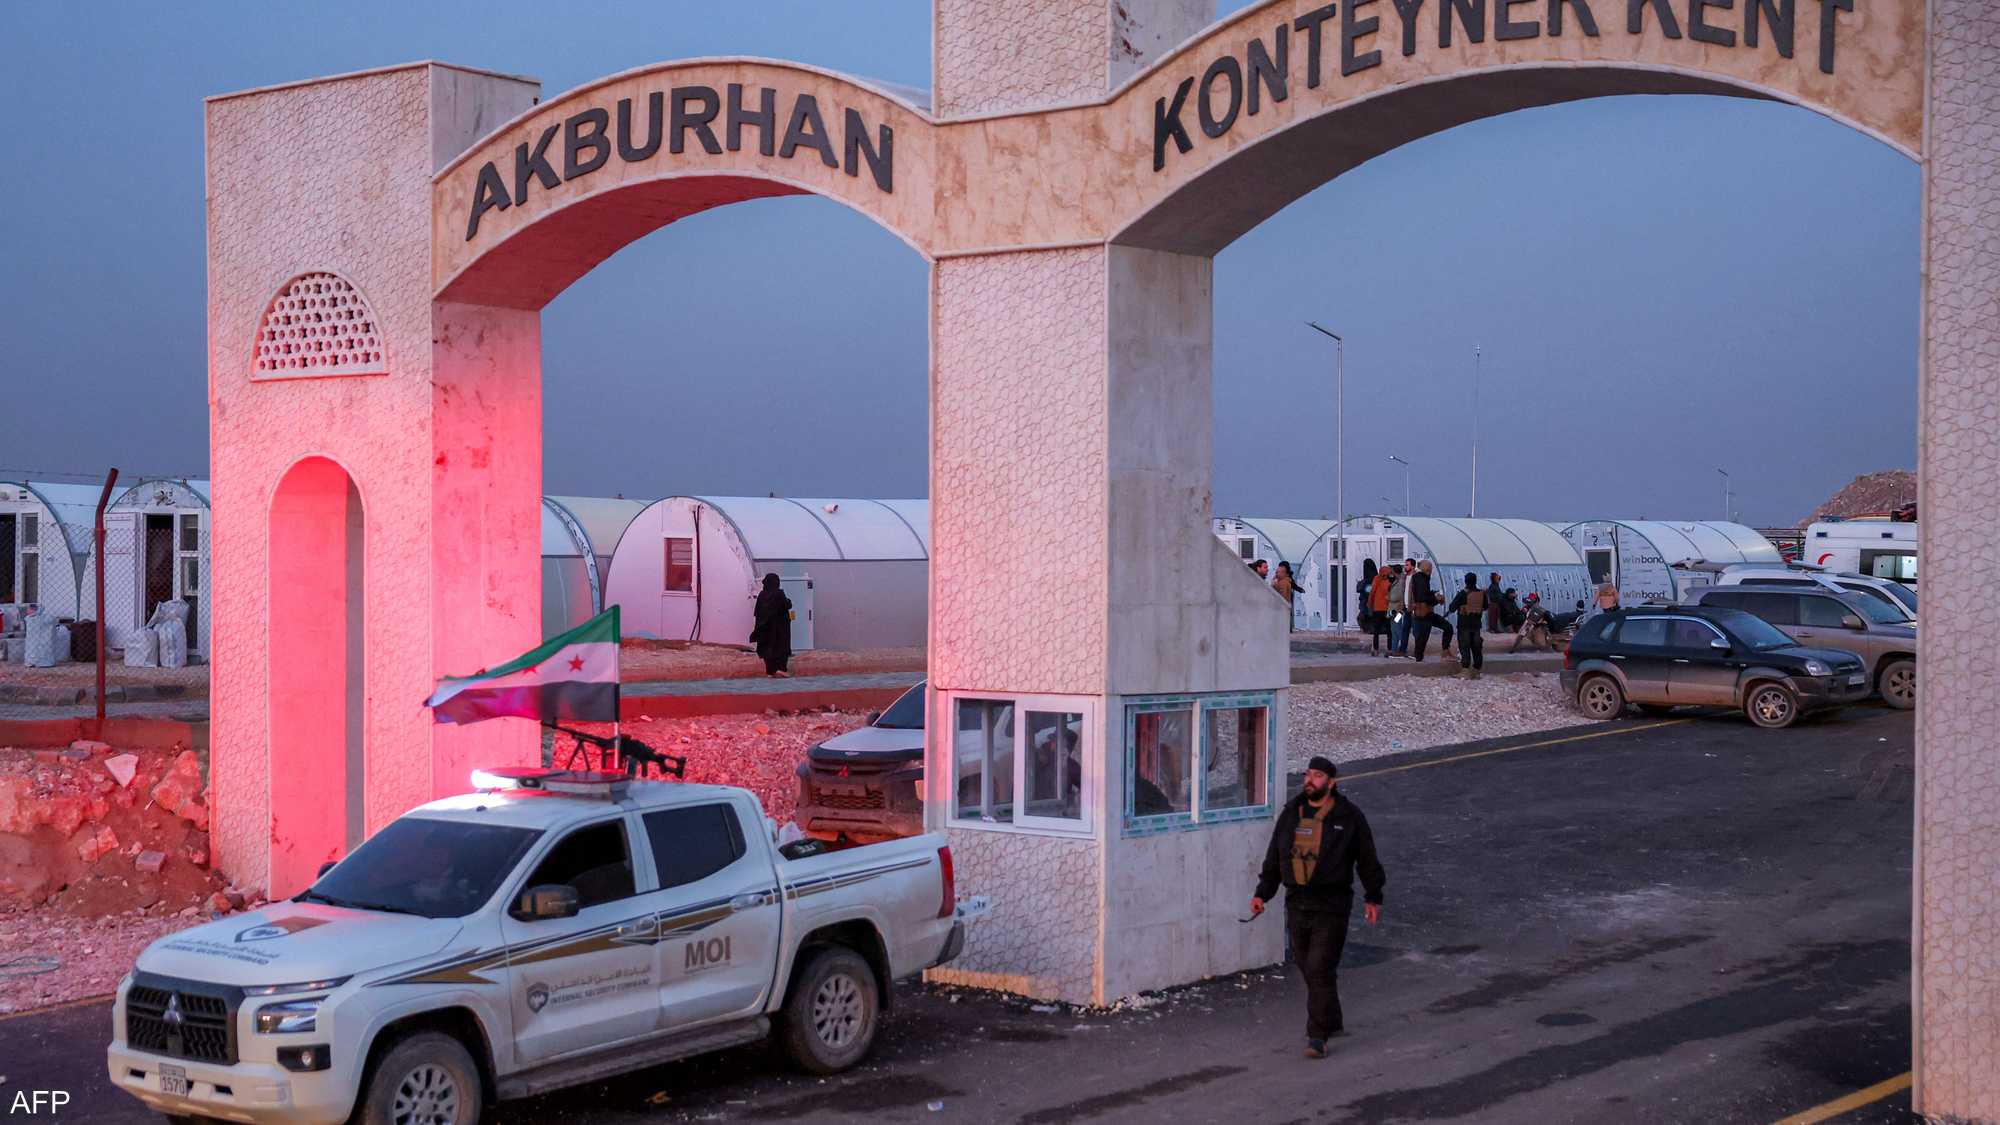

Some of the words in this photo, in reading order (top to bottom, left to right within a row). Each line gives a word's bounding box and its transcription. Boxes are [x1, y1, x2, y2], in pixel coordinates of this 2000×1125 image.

[465, 83, 893, 241] AKBURHAN
[1153, 0, 1599, 171] KONTEYNER
[685, 936, 731, 968] MOI
